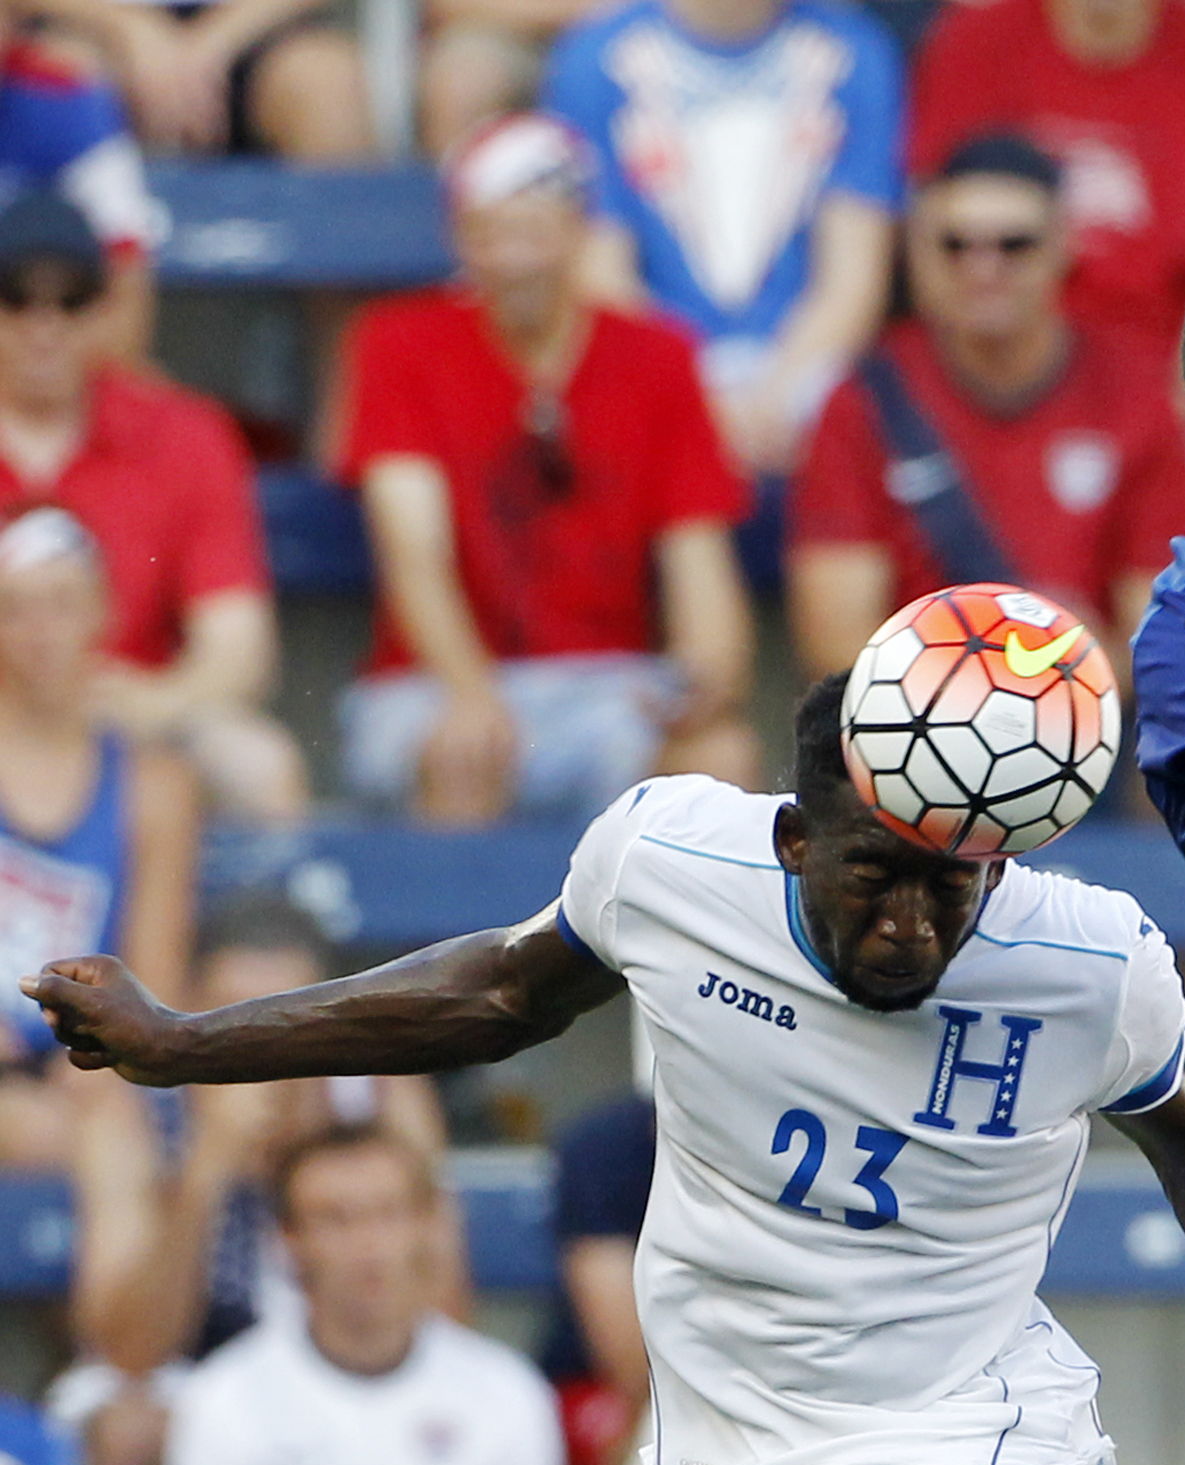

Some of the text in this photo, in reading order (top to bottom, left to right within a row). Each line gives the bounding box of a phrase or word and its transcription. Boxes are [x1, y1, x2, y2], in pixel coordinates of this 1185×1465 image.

[913, 1004, 1043, 1137] H
[931, 1024, 961, 1115] HONDURAS
[771, 1108, 911, 1231] 23
